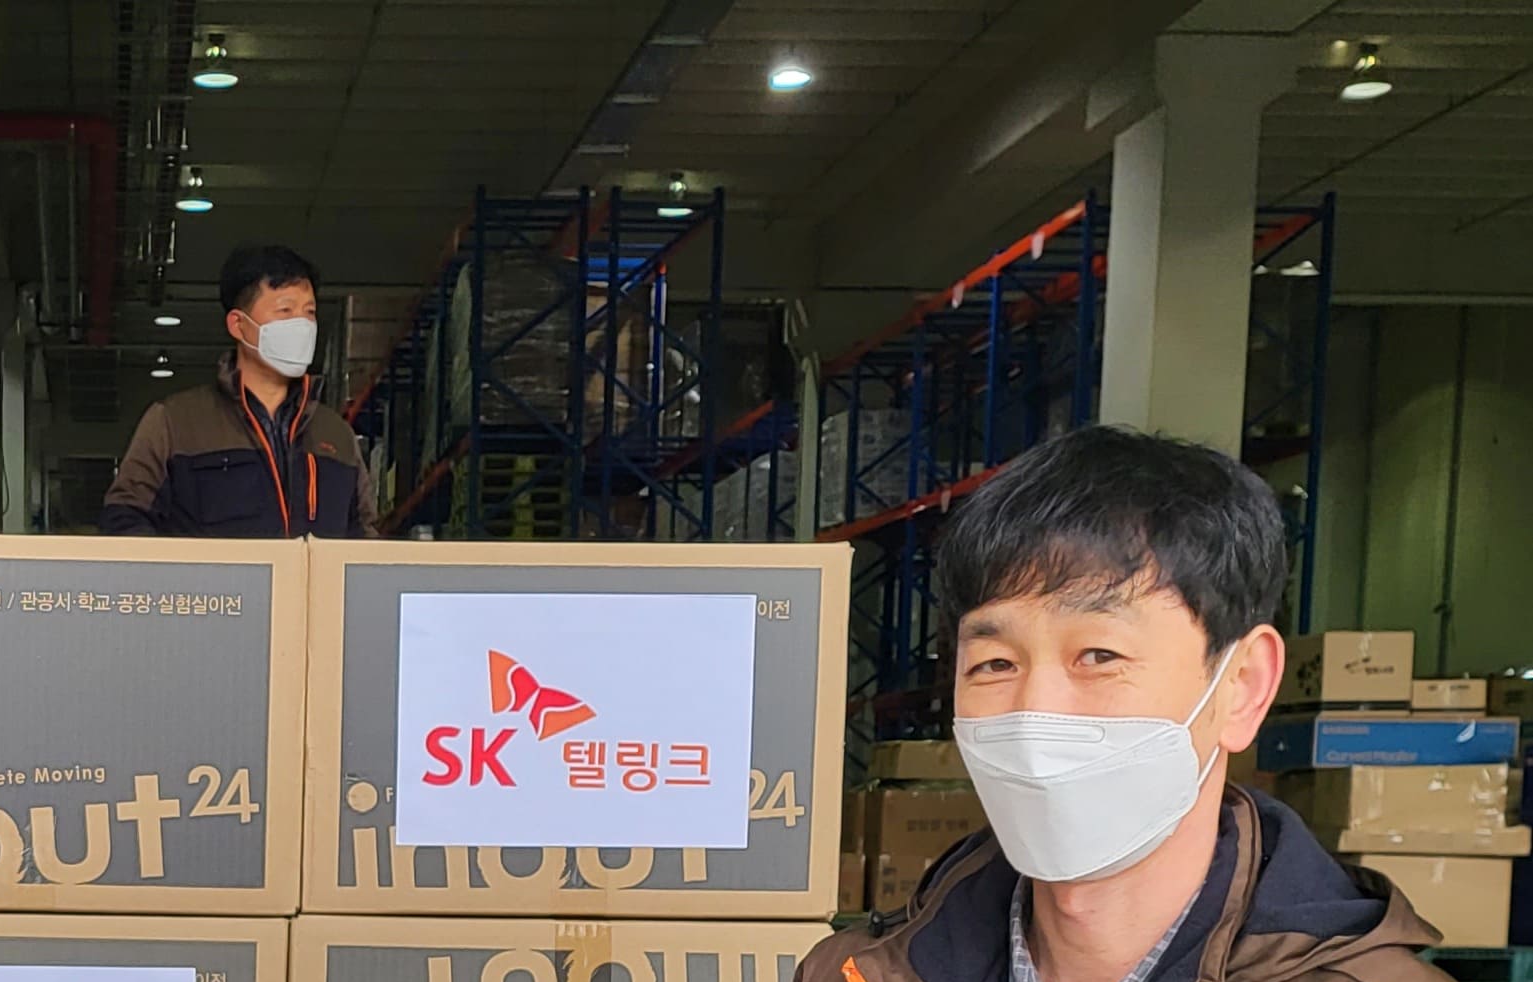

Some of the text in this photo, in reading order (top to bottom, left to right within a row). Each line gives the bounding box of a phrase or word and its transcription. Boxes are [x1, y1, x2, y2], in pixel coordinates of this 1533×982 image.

[34, 764, 106, 784] Moving
[422, 726, 712, 792] SK 텔링크
[187, 765, 260, 824] 24
